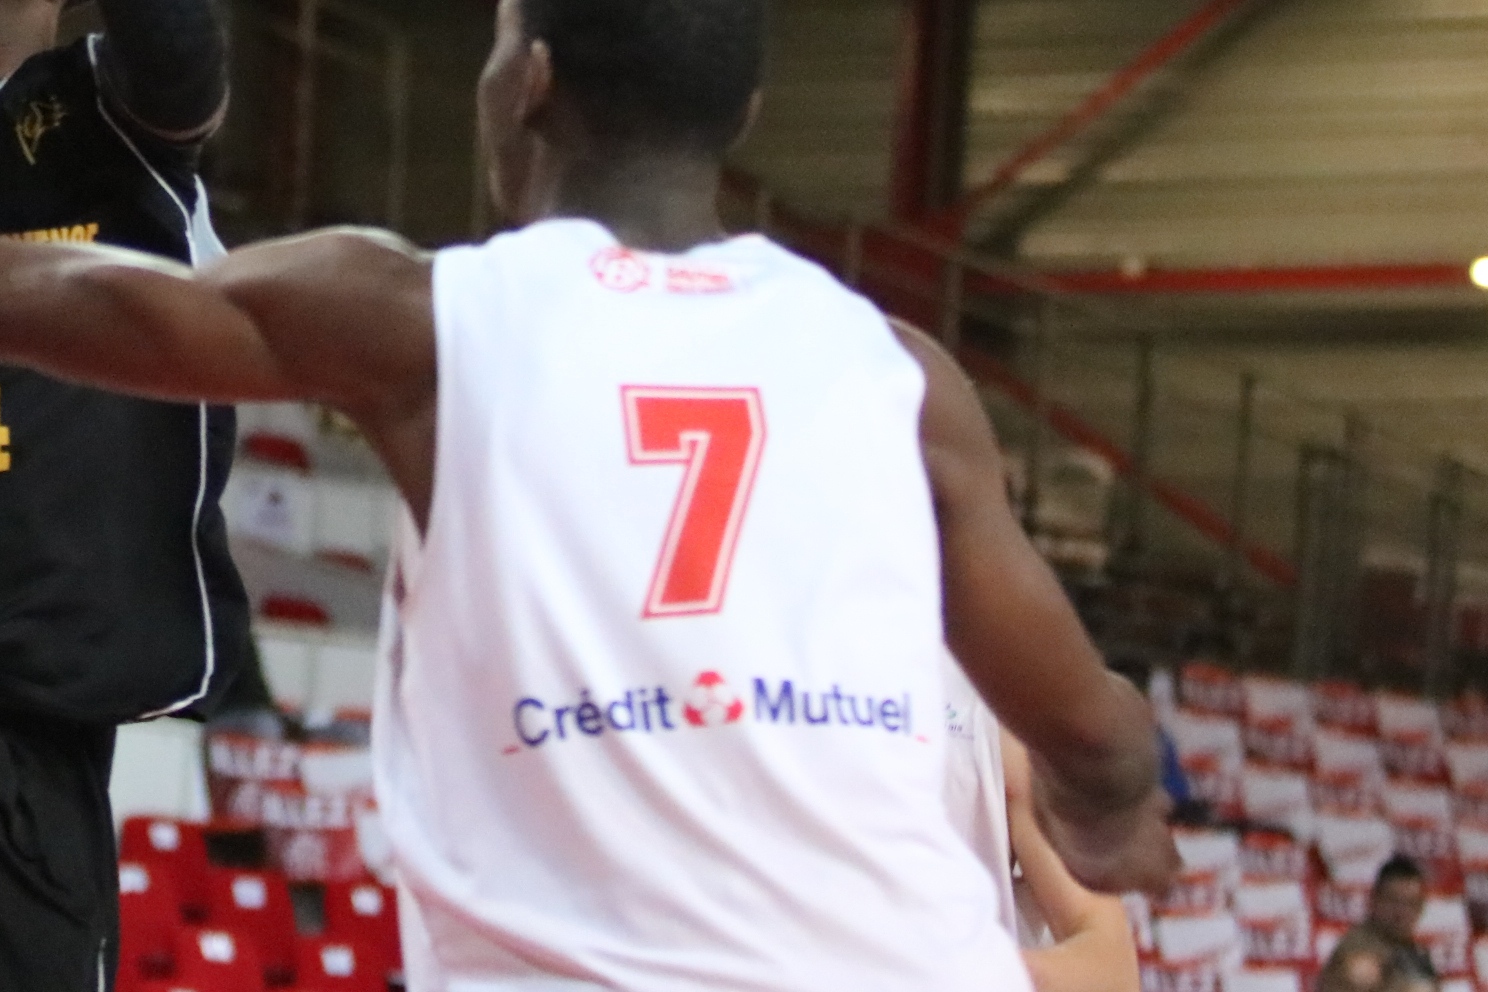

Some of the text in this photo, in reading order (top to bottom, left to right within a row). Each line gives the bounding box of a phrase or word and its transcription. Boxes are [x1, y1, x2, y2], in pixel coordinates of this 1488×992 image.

[620, 384, 767, 619] 7
[513, 676, 913, 748] Crédit Mutuel
